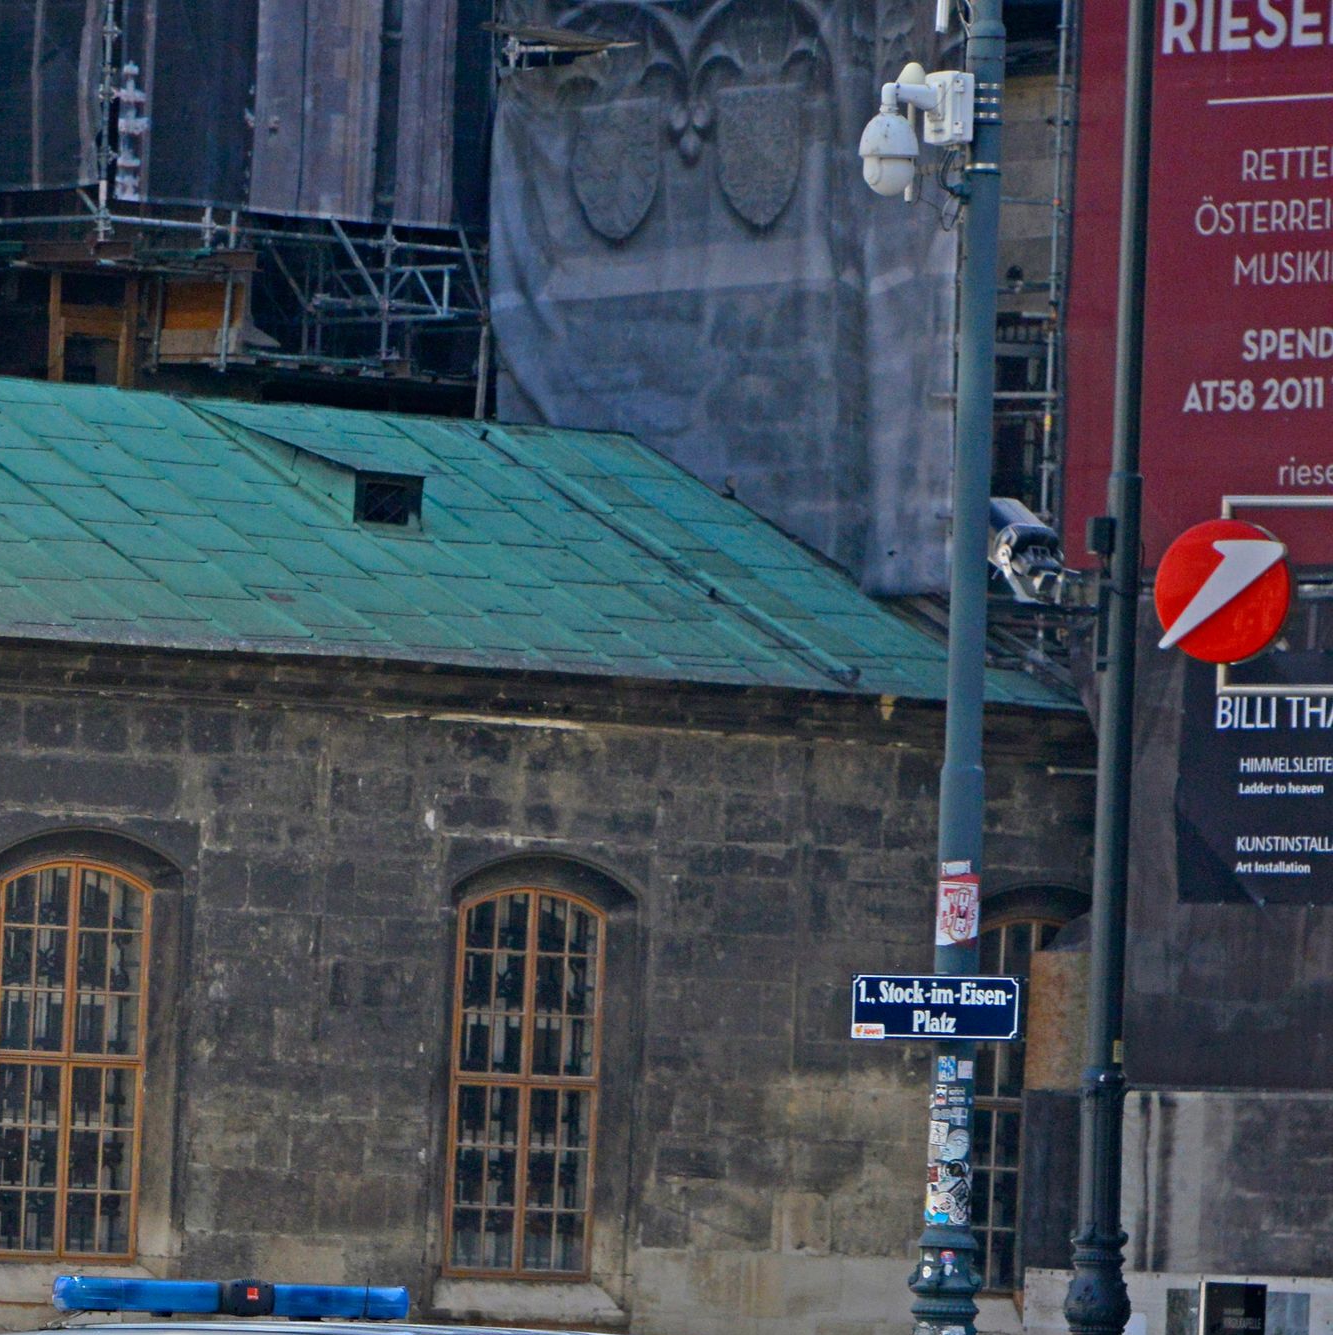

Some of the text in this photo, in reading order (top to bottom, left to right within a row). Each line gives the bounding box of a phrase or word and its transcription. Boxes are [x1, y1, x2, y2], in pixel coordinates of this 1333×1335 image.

[1162, 0, 1333, 54] RIESE
[1242, 145, 1333, 181] RETTE
[1195, 195, 1333, 236] ÖSTERREI
[1234, 250, 1333, 285] MUSIKI
[1183, 380, 1255, 412] AT58
[1262, 377, 1324, 410] 2011
[1215, 697, 1277, 729] BILLI
[1239, 757, 1333, 773] HIMMELSLEITE
[1238, 782, 1324, 794] Ladder to heaven
[1236, 836, 1333, 852] KUNSTINSTALL
[1235, 861, 1311, 873] Art Installation
[879, 980, 1013, 1006] Stock-im-Eisen-
[912, 1010, 957, 1034] Platz
